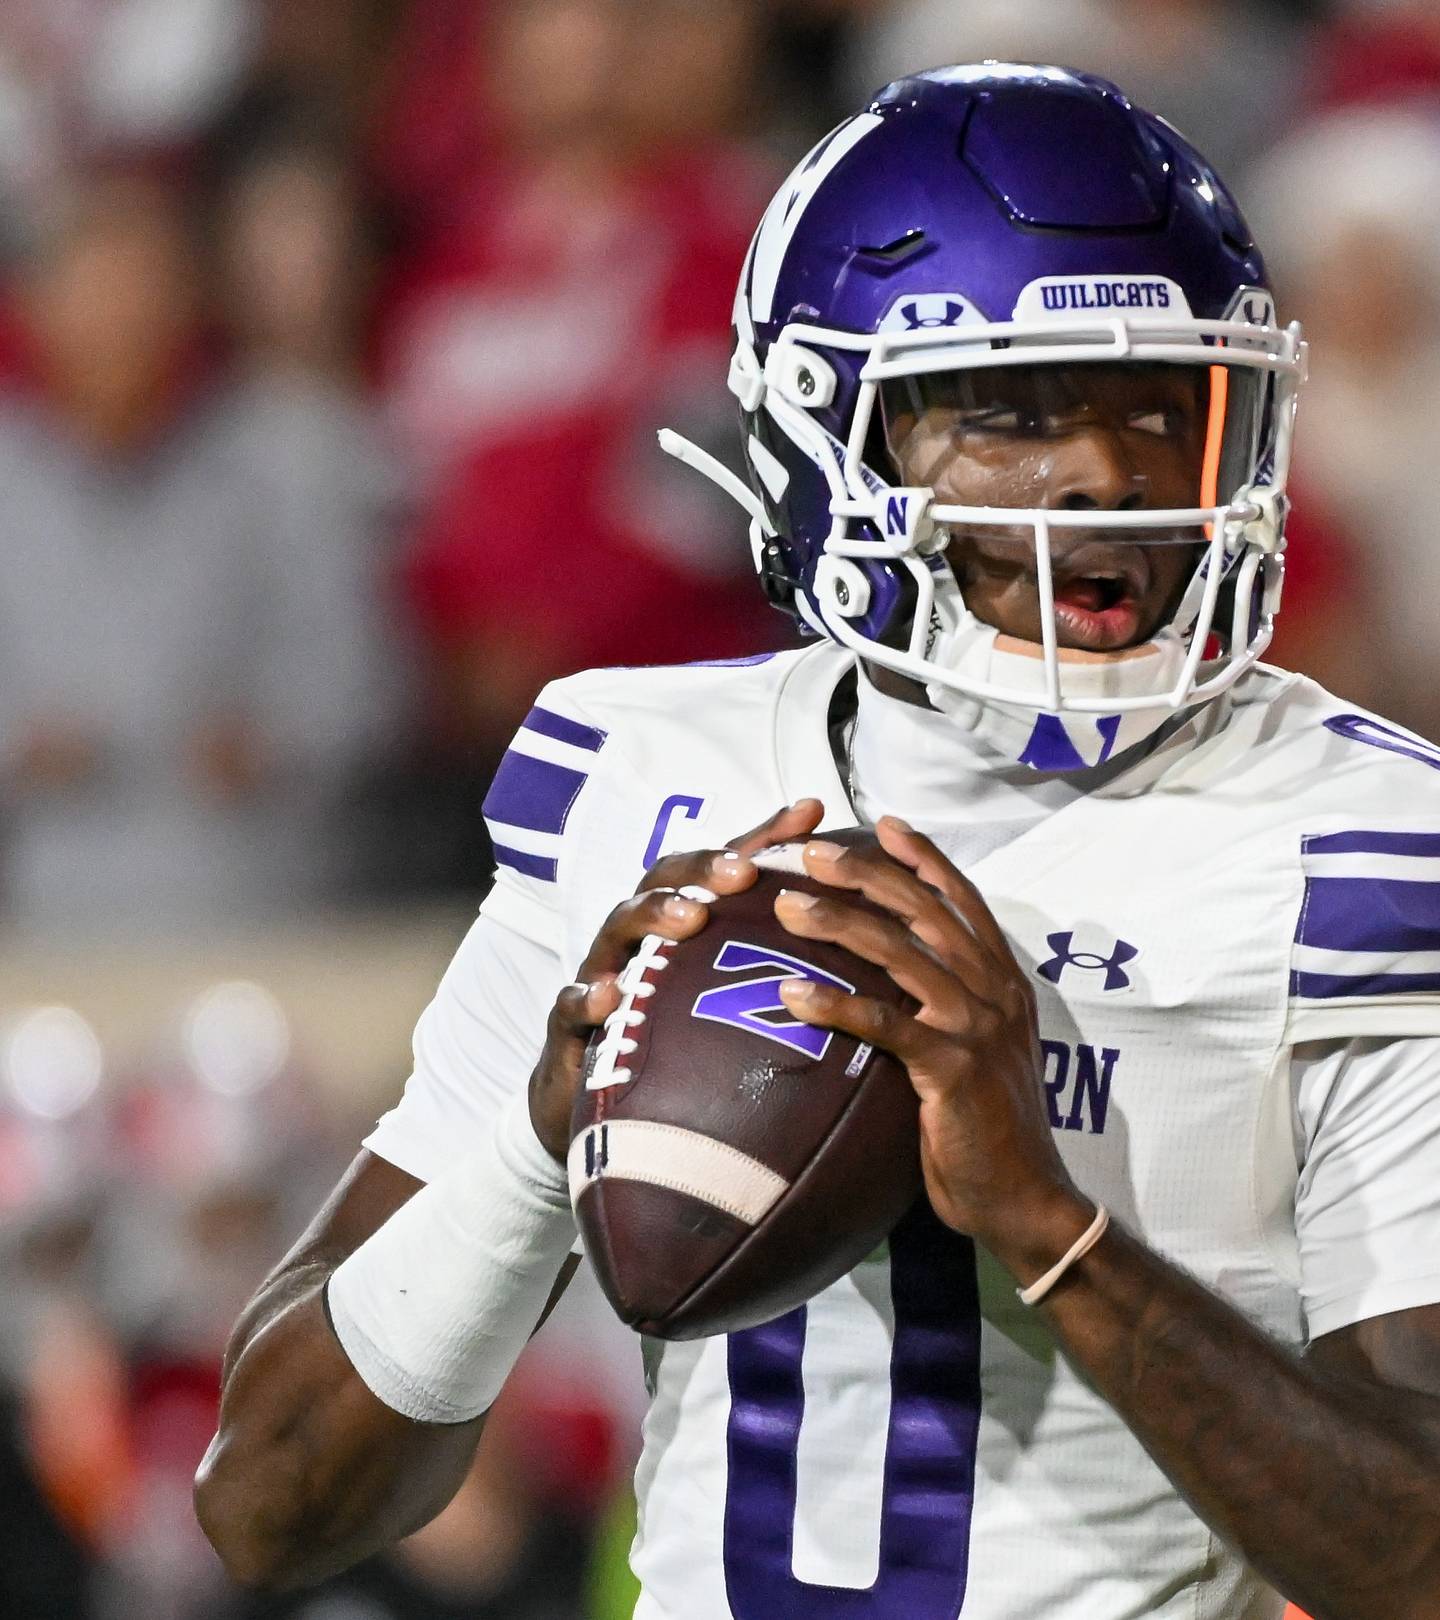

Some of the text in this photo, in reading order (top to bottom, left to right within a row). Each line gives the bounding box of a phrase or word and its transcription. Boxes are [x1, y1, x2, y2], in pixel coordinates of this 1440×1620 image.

[1040, 282, 1170, 310] WILDCATS
[887, 496, 908, 536] N
[1017, 713, 1122, 772] N
[643, 794, 705, 872] C
[691, 941, 856, 1061] N
